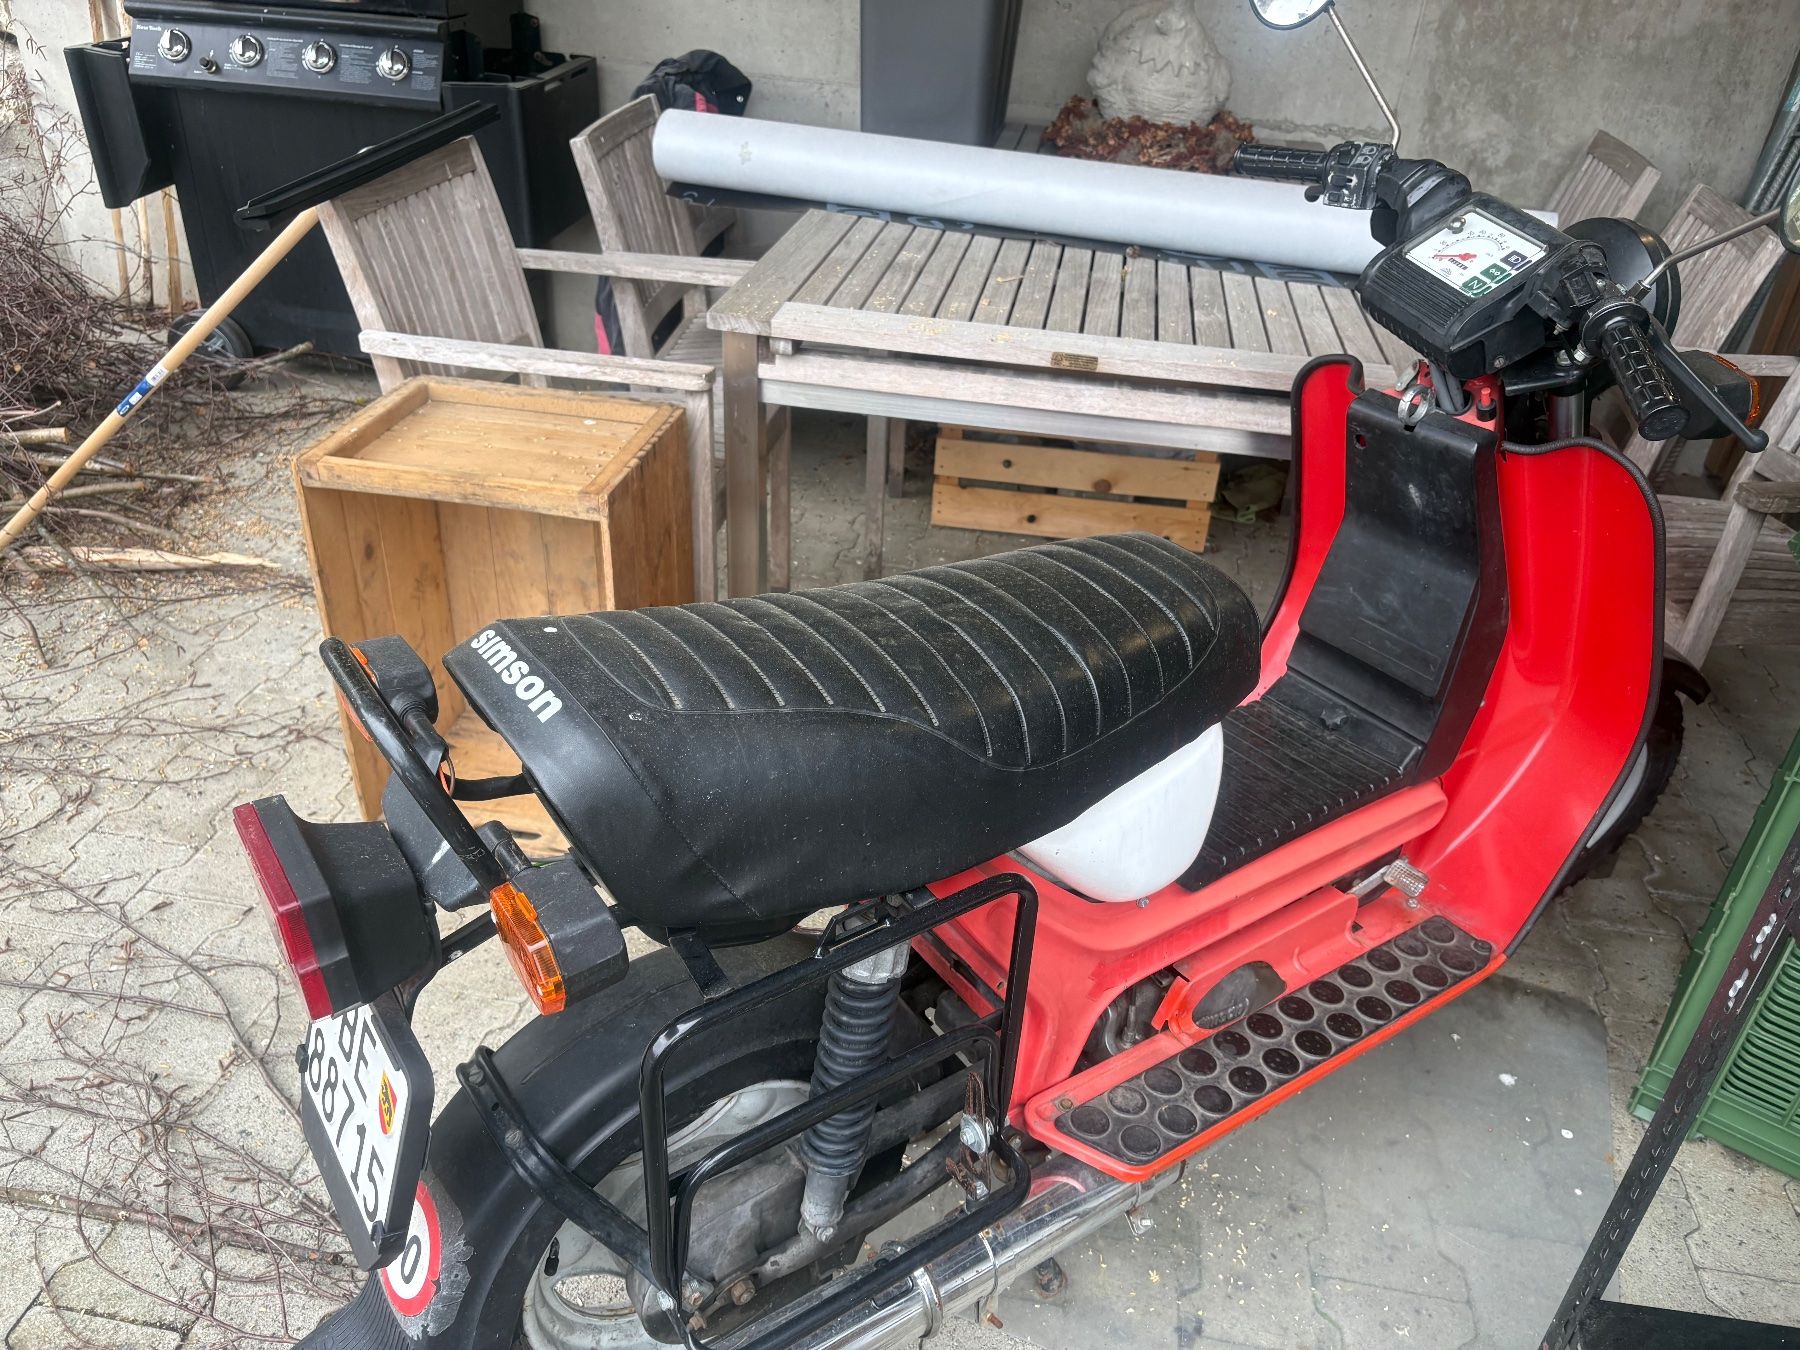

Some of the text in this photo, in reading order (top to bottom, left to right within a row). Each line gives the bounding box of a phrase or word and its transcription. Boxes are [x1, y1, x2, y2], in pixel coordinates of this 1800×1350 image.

[470, 629, 563, 724] simson
[338, 1008, 377, 1104] BE
[309, 1027, 385, 1223] 88715
[400, 1234, 421, 1285] 0
